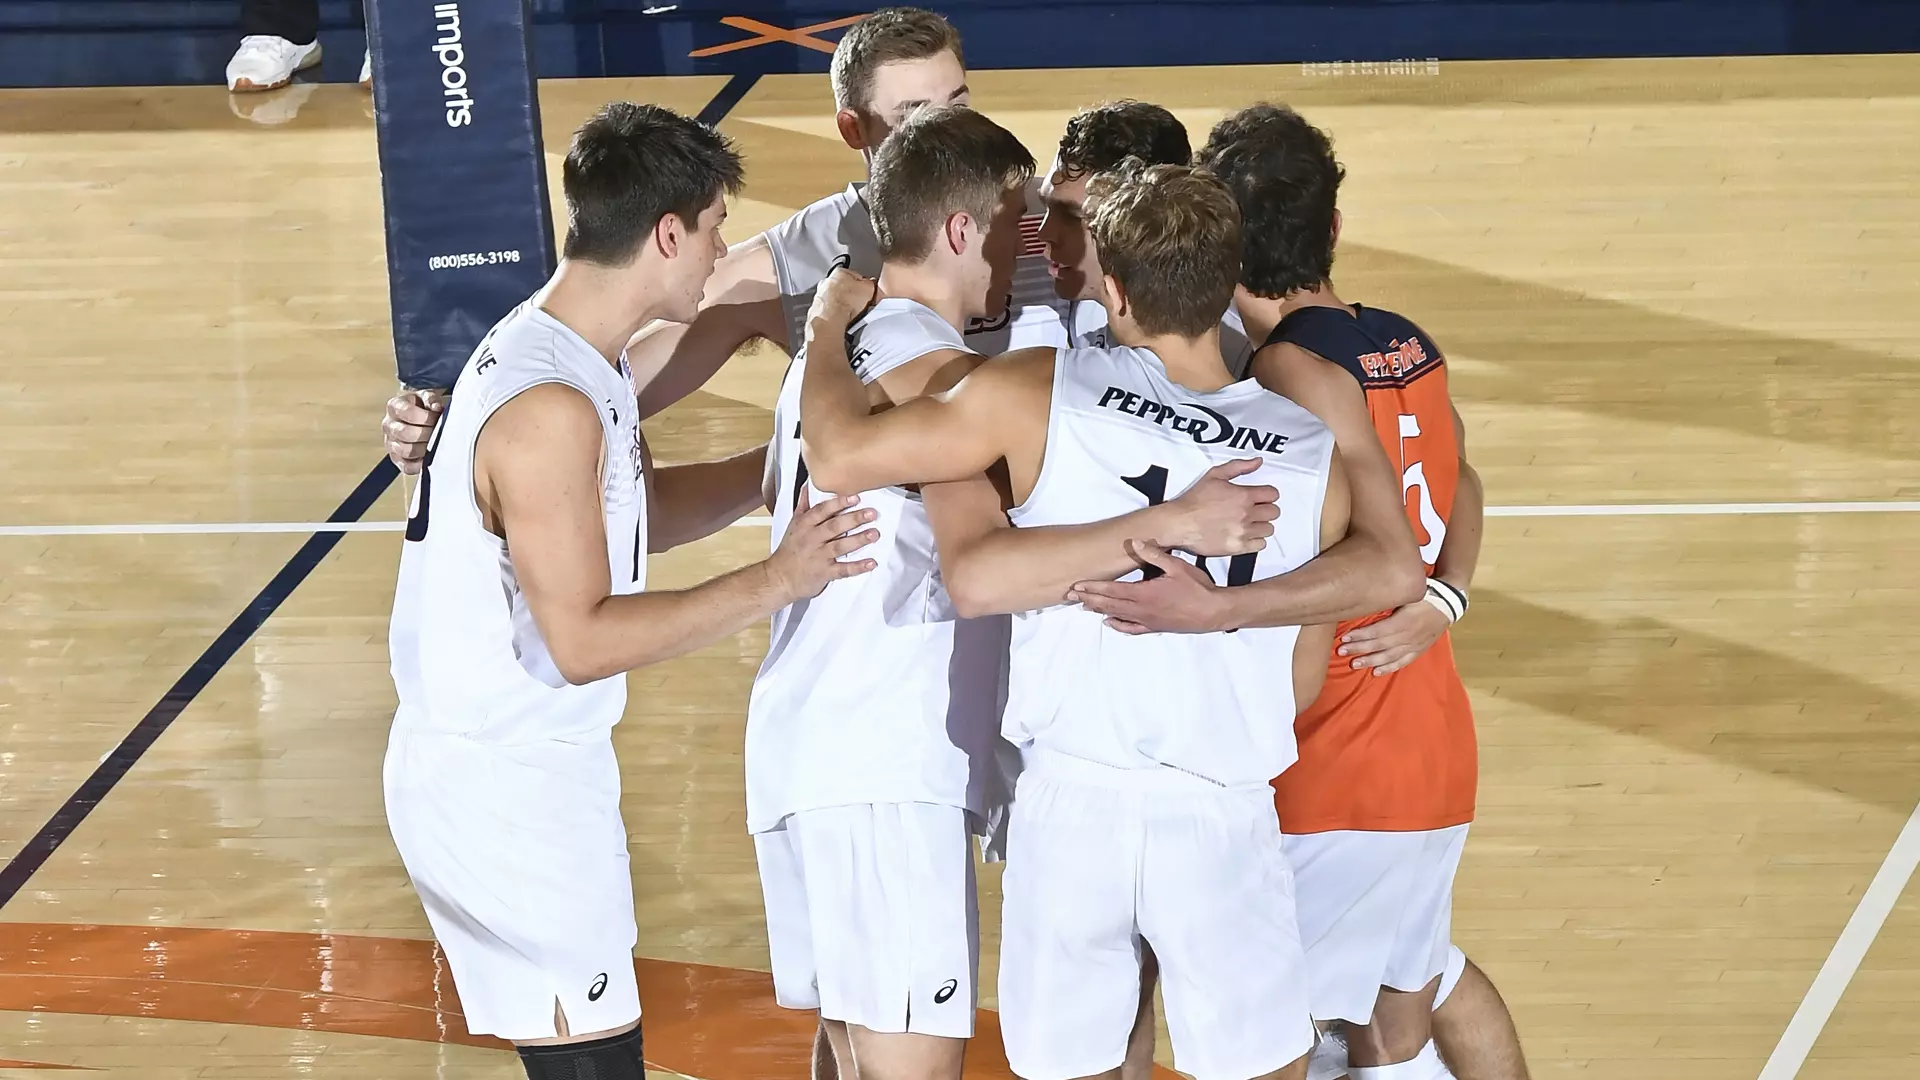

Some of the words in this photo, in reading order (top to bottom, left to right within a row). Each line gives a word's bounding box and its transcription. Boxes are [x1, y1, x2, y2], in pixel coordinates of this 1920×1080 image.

[432, 3, 474, 128] imports
[428, 250, 520, 271] (800)556-3198
[1097, 386, 1289, 454] PEPPERDINE
